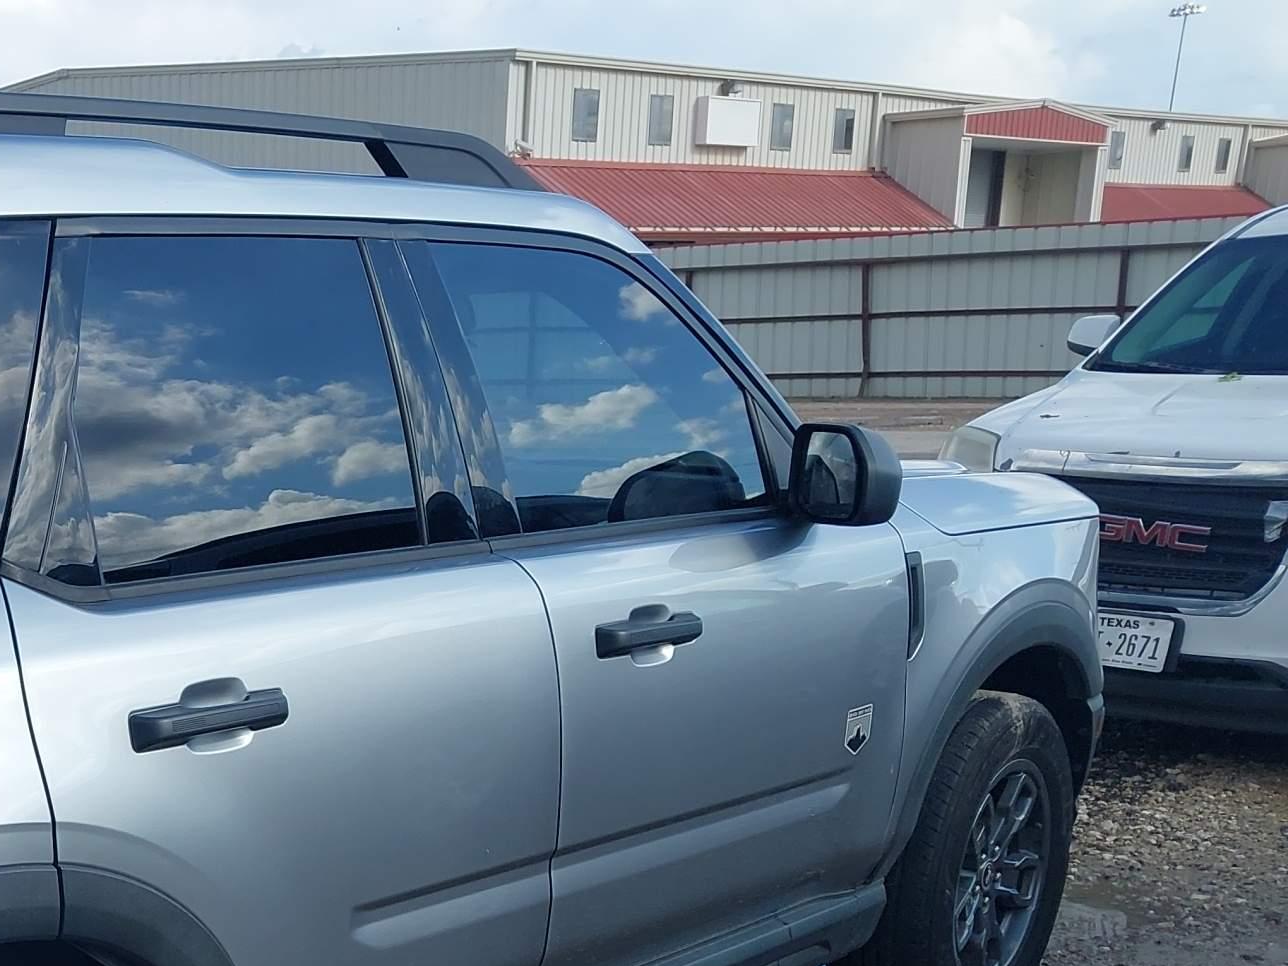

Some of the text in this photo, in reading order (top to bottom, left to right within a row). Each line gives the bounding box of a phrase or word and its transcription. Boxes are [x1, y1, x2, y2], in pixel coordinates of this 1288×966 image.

[1099, 513, 1212, 552] GMC
[1100, 617, 1140, 629] TEXAS
[1115, 633, 1160, 660] 2671
